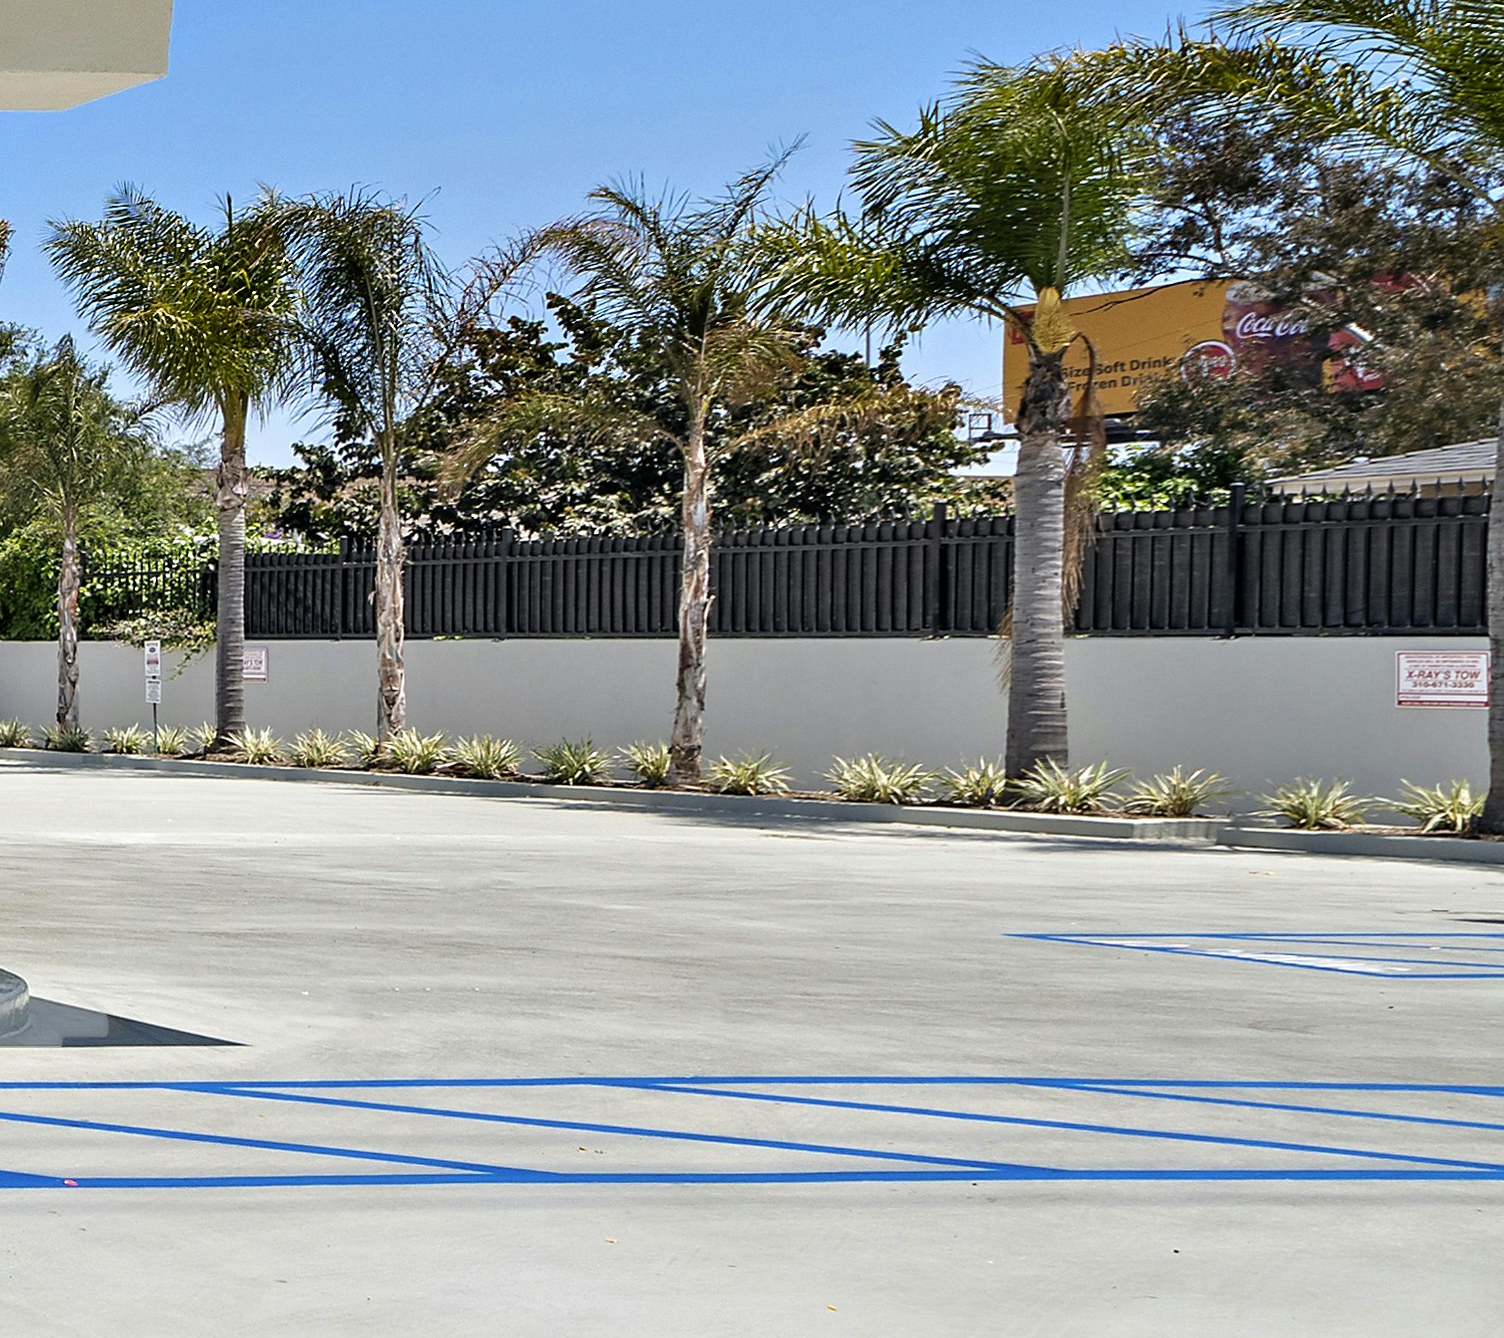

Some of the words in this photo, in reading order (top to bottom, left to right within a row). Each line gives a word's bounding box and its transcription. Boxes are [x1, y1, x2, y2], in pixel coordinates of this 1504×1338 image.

[1095, 360, 1126, 375] Soft
[1068, 379, 1118, 392] Froen
[1455, 670, 1481, 680] TOW
